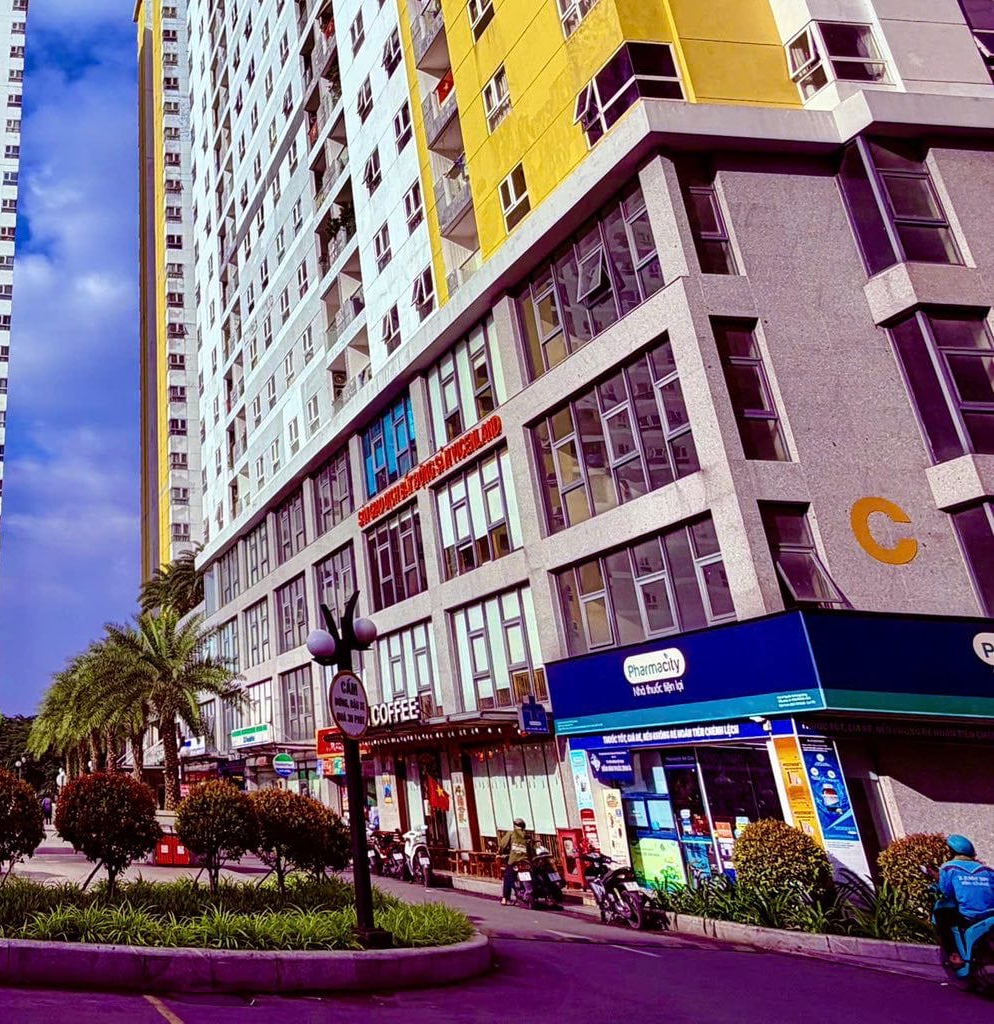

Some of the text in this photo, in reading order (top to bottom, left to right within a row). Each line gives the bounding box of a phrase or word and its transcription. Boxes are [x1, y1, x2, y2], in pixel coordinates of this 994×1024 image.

[850, 496, 918, 565] C
[627, 653, 680, 678] Pharmacity
[340, 678, 358, 696] CẤM
[632, 684, 646, 697] Nhà
[646, 681, 663, 695] thuốc
[675, 679, 684, 693] lợi
[371, 698, 418, 727] COFFEE
